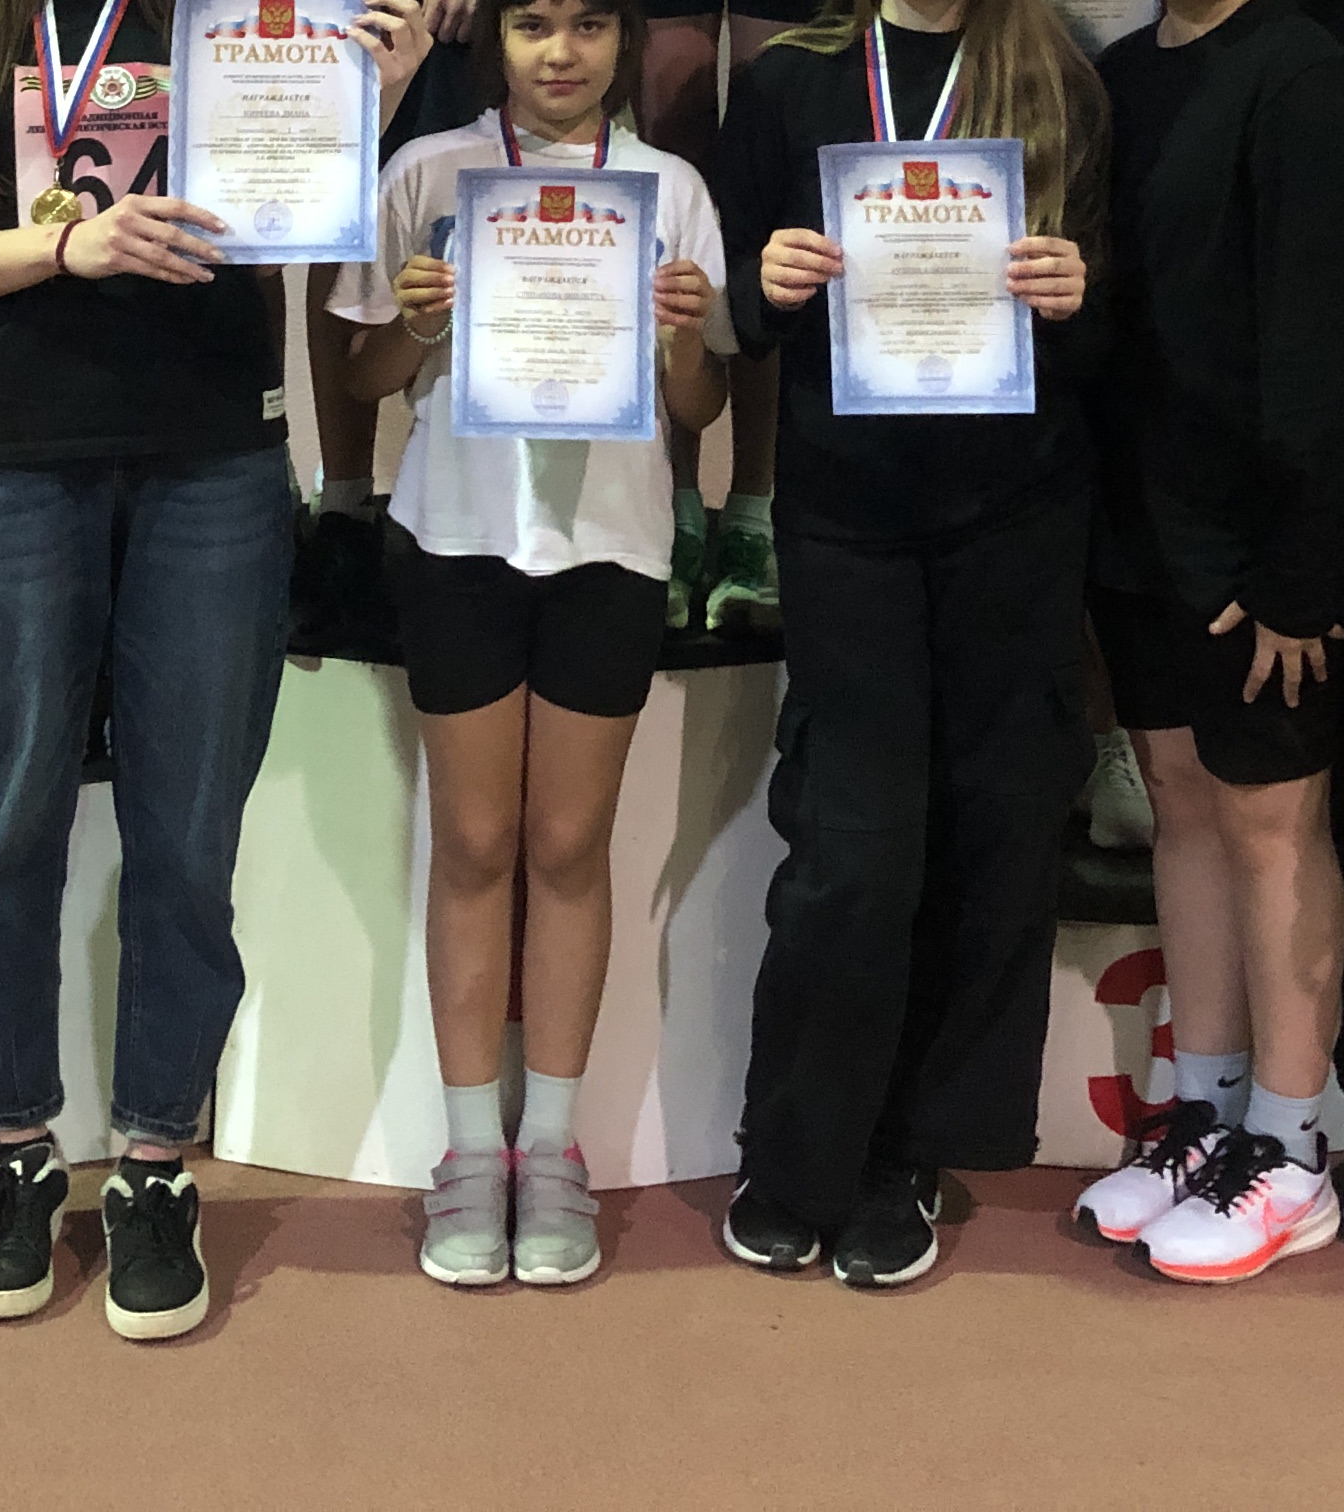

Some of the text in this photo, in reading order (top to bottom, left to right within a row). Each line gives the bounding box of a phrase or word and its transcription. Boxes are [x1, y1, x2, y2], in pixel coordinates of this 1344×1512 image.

[212, 43, 340, 64] ГРАМОТА
[57, 135, 168, 216] 64
[863, 204, 986, 224] ГРАМОТА
[495, 226, 617, 247] ГРАМОТА
